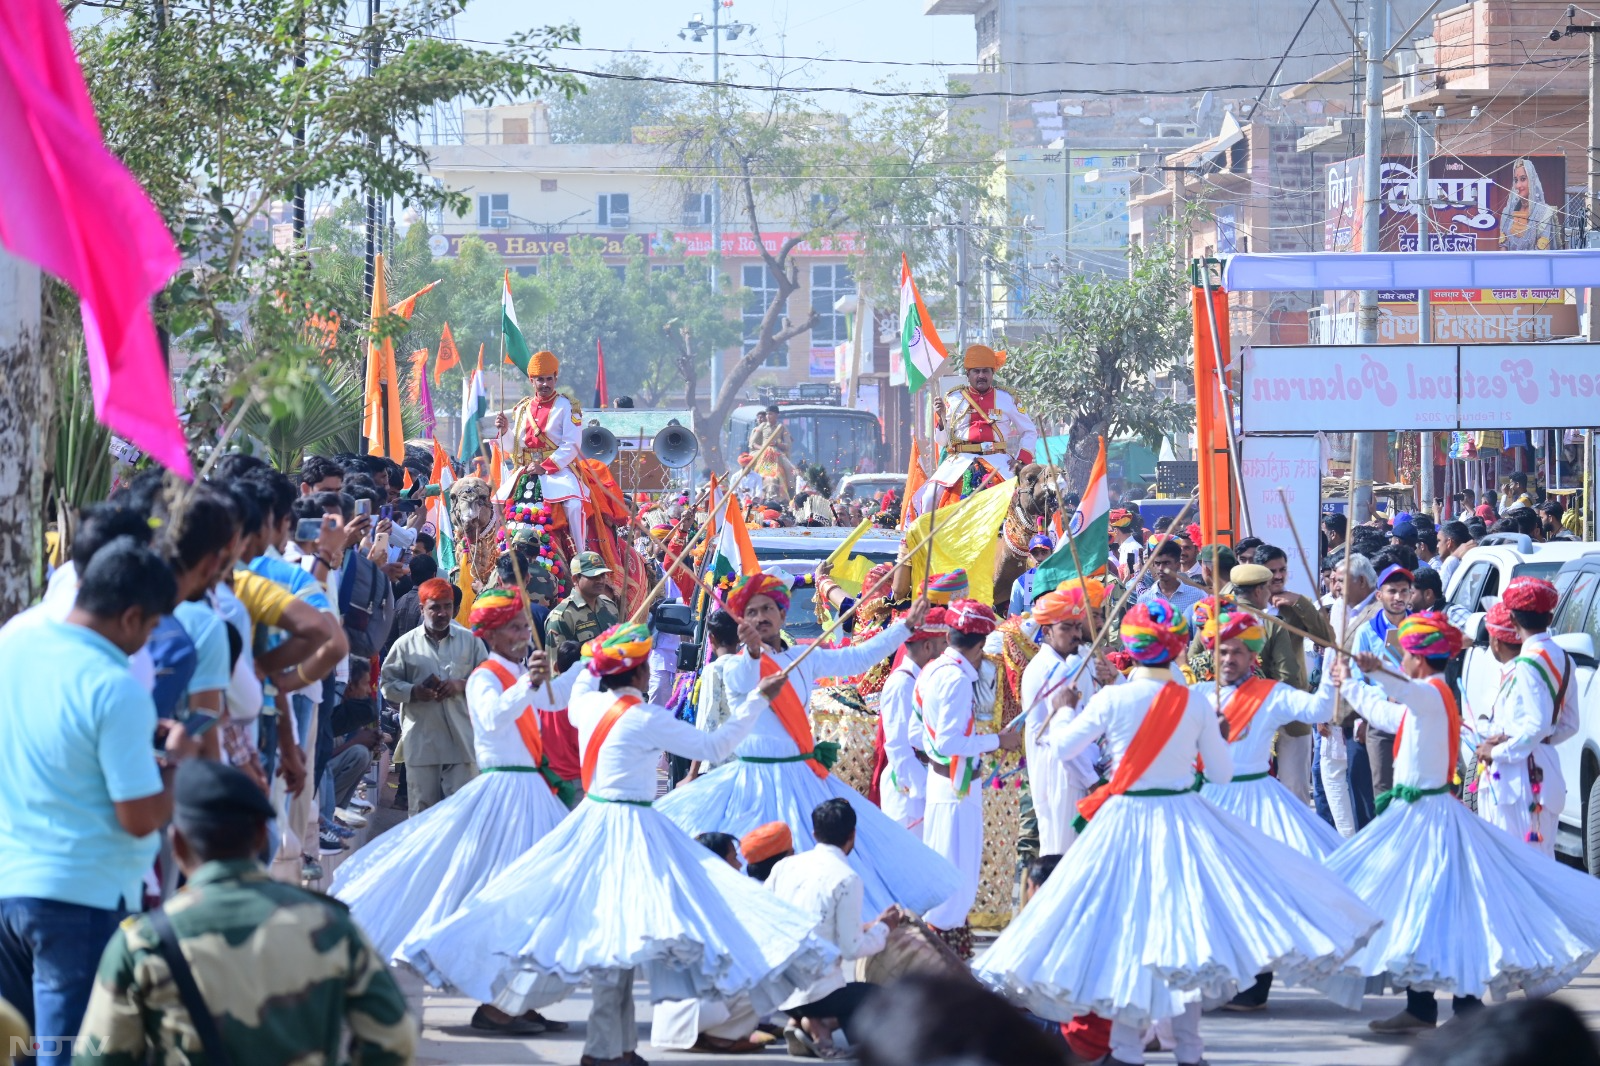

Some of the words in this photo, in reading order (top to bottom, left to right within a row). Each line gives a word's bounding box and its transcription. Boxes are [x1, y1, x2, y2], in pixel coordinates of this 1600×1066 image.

[452, 237, 498, 254] Te
[505, 234, 583, 254] Have
[592, 236, 645, 254] Ca
[674, 236, 734, 251] ahaev
[738, 236, 777, 251] Rom
[1322, 503, 1335, 512] 45
